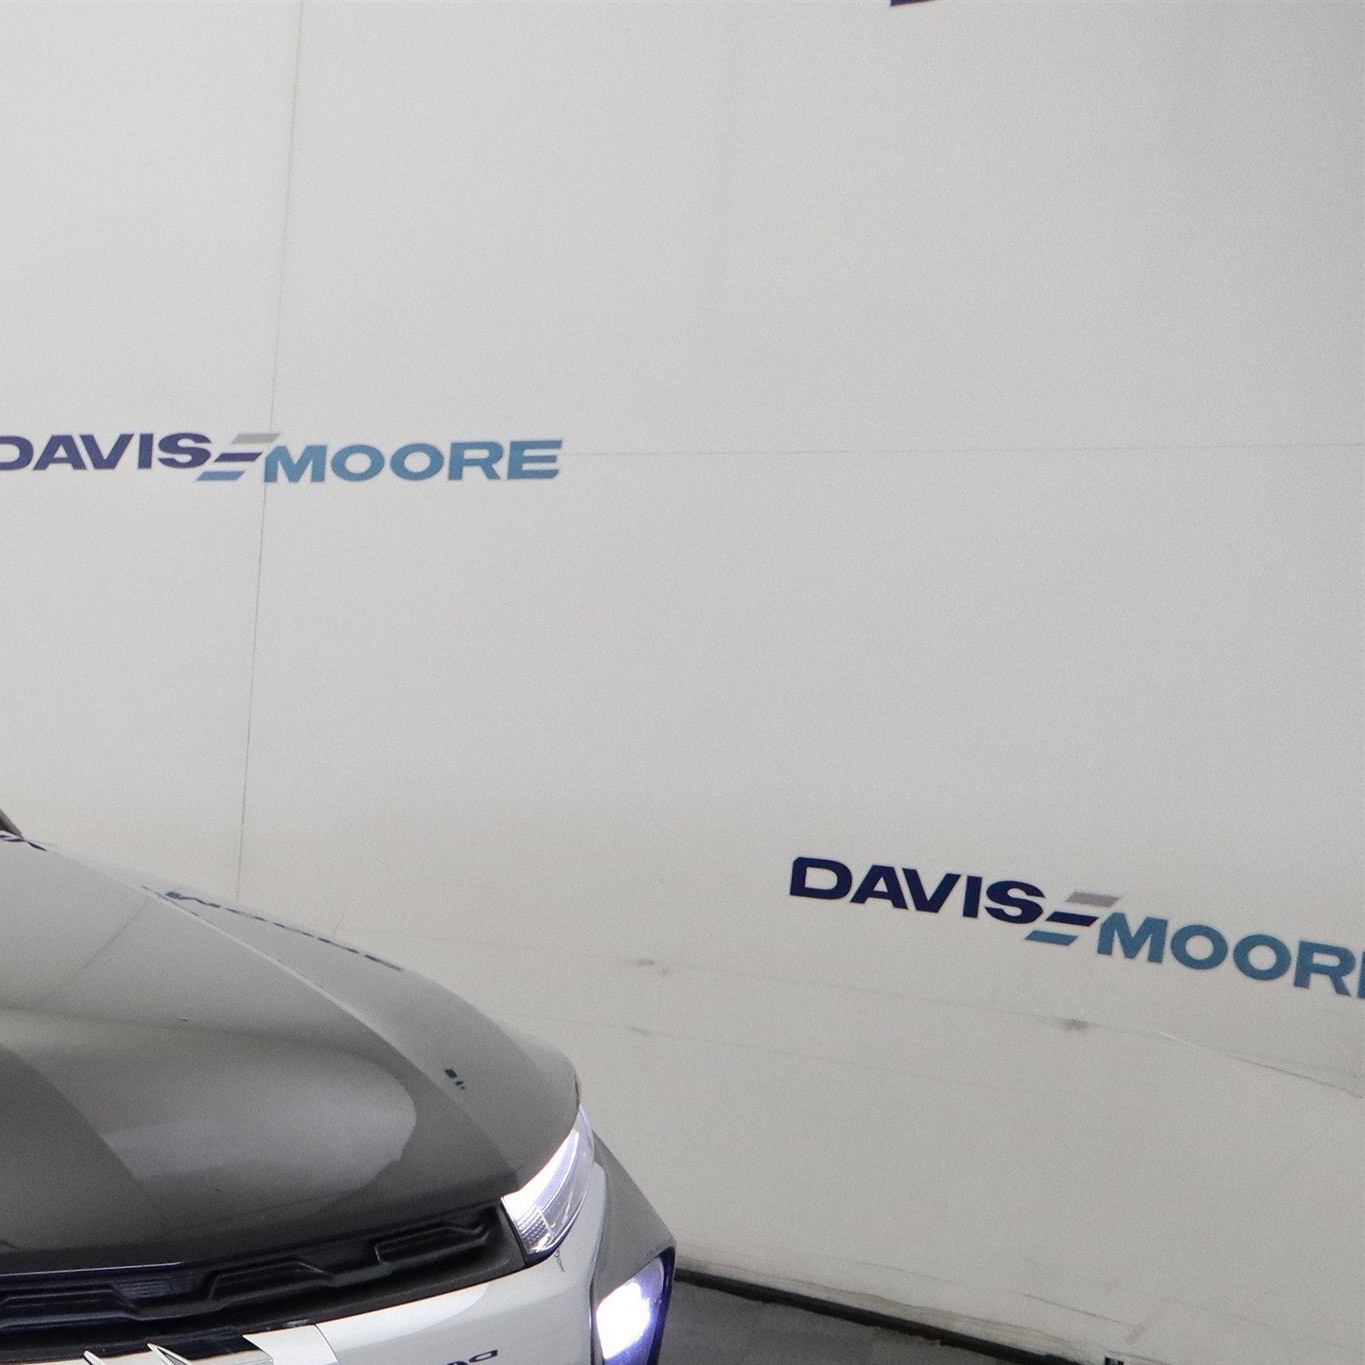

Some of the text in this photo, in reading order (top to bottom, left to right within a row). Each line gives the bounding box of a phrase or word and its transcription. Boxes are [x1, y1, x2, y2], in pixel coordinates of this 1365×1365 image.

[263, 439, 562, 484] MOORE
[788, 856, 1365, 1000] DAVIS MOOR
